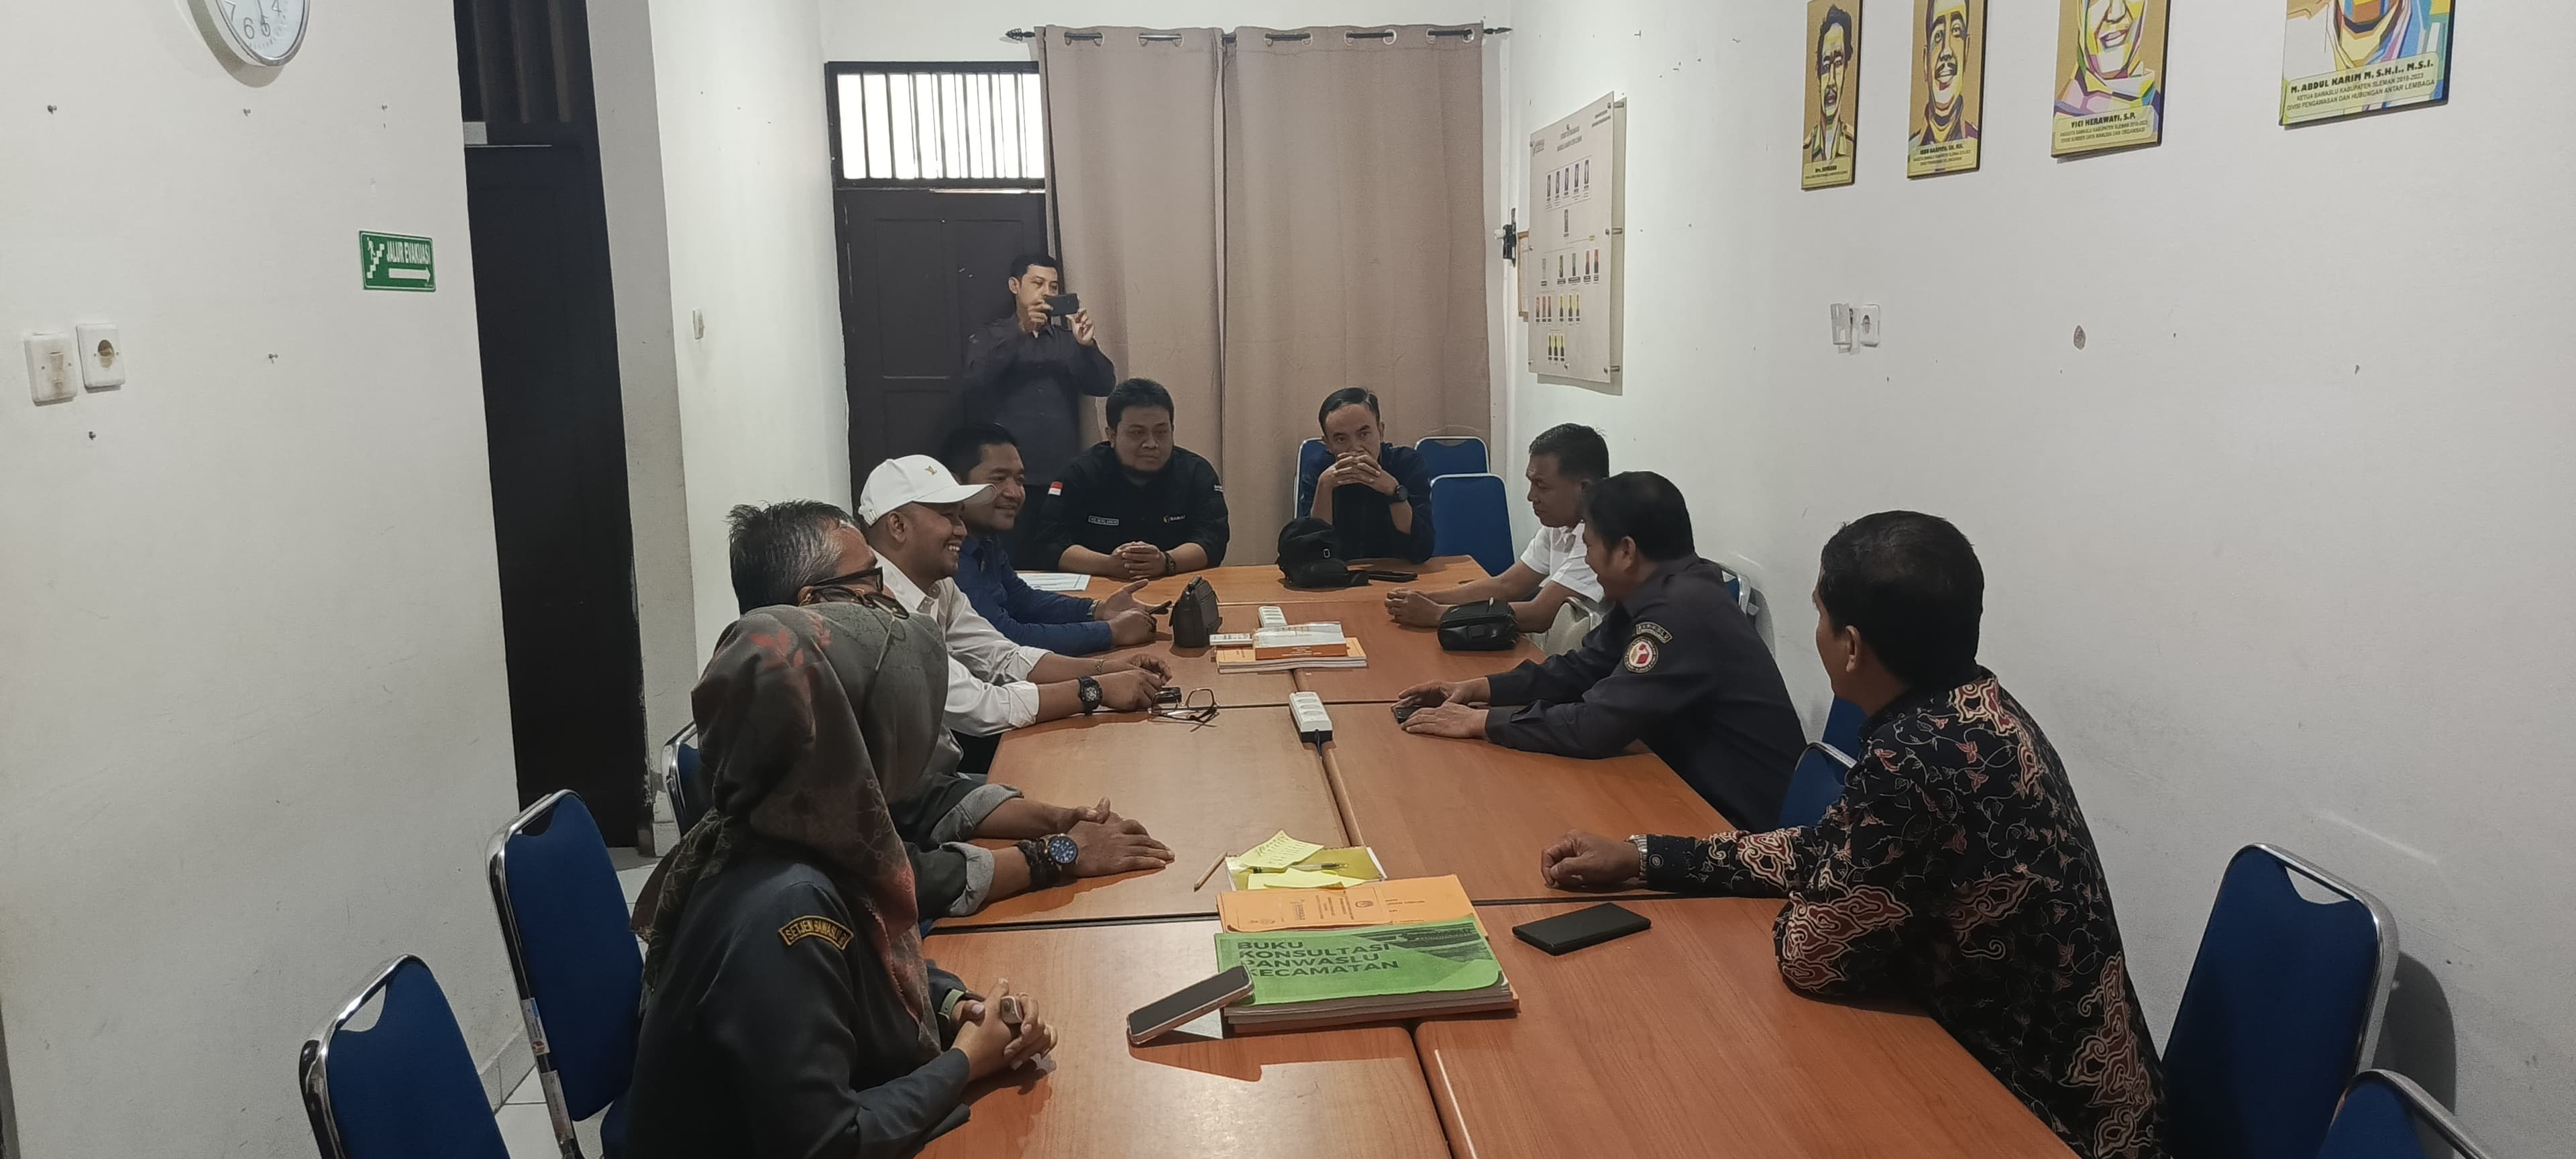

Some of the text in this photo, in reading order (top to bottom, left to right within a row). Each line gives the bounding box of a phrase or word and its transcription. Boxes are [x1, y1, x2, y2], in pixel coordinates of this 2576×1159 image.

[244, 17, 255, 40] 6
[2301, 80, 2329, 92] ABDUL
[2332, 73, 2361, 86] KARIM
[2314, 89, 2339, 99] BAWASLU
[2340, 82, 2371, 93] KABUPATEN
[2372, 78, 2396, 87] SLEMAN
[2302, 97, 2338, 108] PENGAWASAN
[2351, 89, 2383, 100] HUBUNGAN
[2384, 85, 2404, 93] ANTAR
[2405, 79, 2435, 90] LEMBAGA
[386, 241, 431, 265] JALUR EVAKUASI
[785, 919, 814, 940] SETJEN
[1238, 941, 1303, 950] BUKU
[1239, 943, 1391, 958] KONSULTASI
[1241, 953, 1379, 967] PANWASLU
